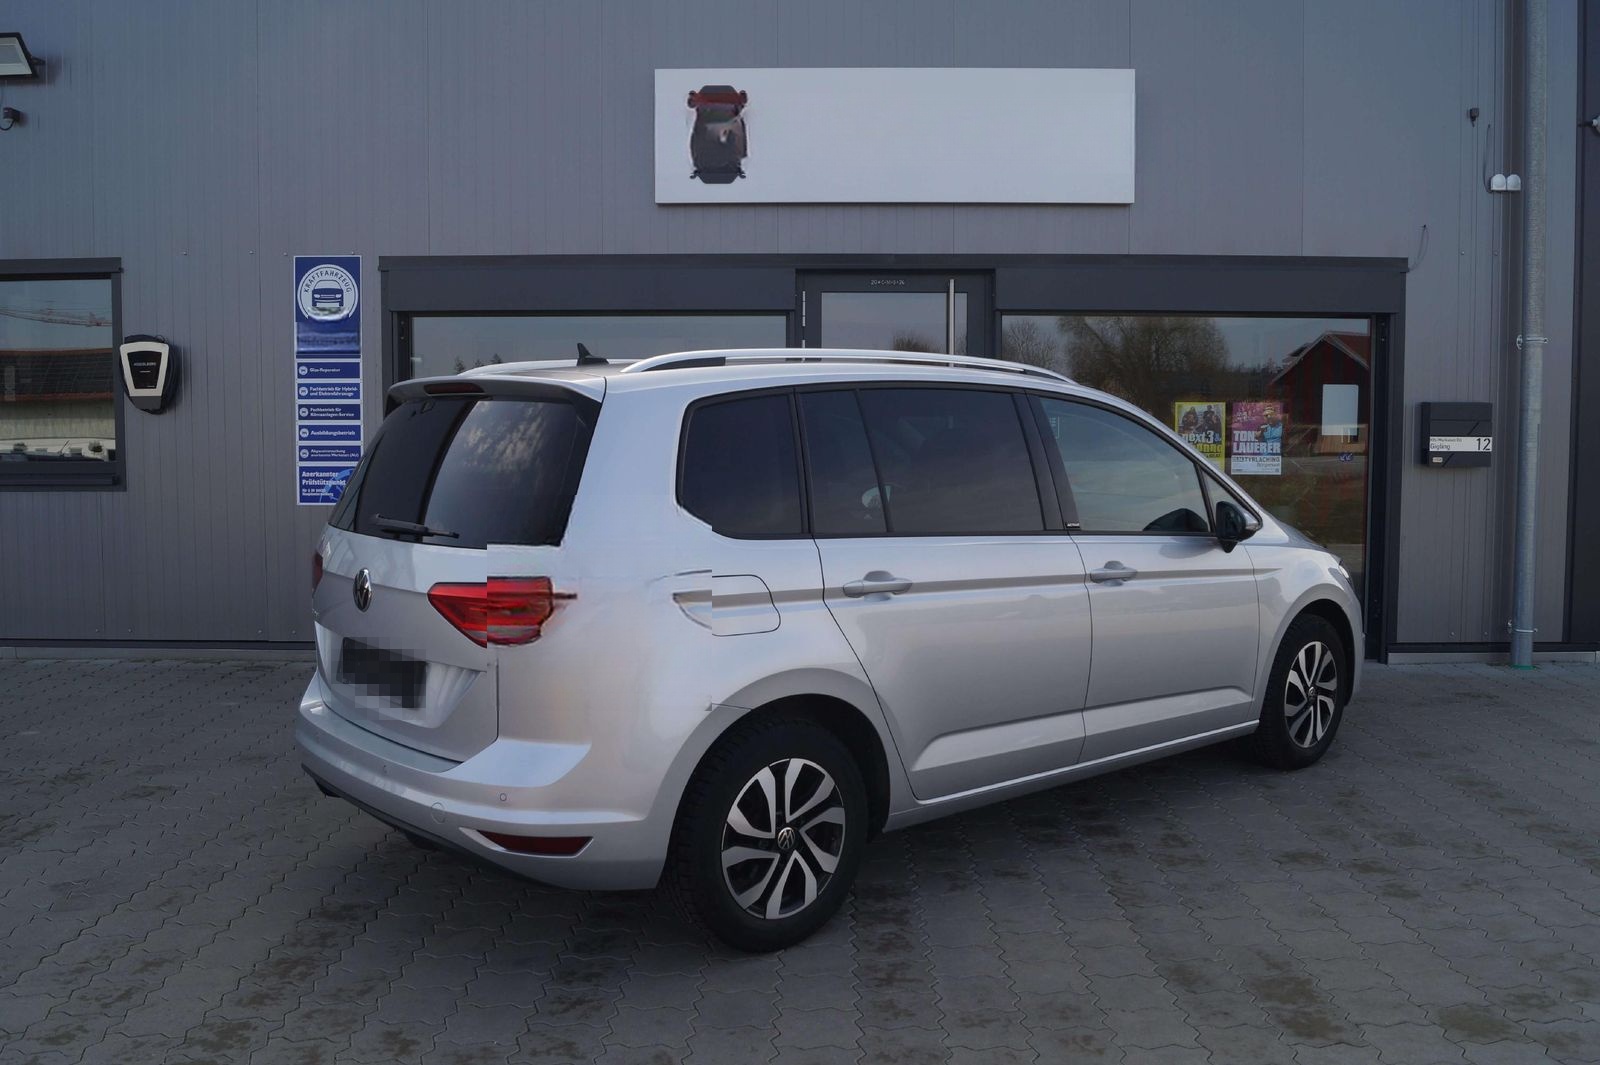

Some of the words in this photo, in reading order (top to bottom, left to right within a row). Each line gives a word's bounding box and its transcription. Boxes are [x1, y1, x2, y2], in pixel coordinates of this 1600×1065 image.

[303, 270, 352, 293] KRAFTFAHRZEUG
[1233, 430, 1258, 442] TON
[1233, 442, 1281, 453] LAUERER
[1476, 438, 1491, 451] 12
